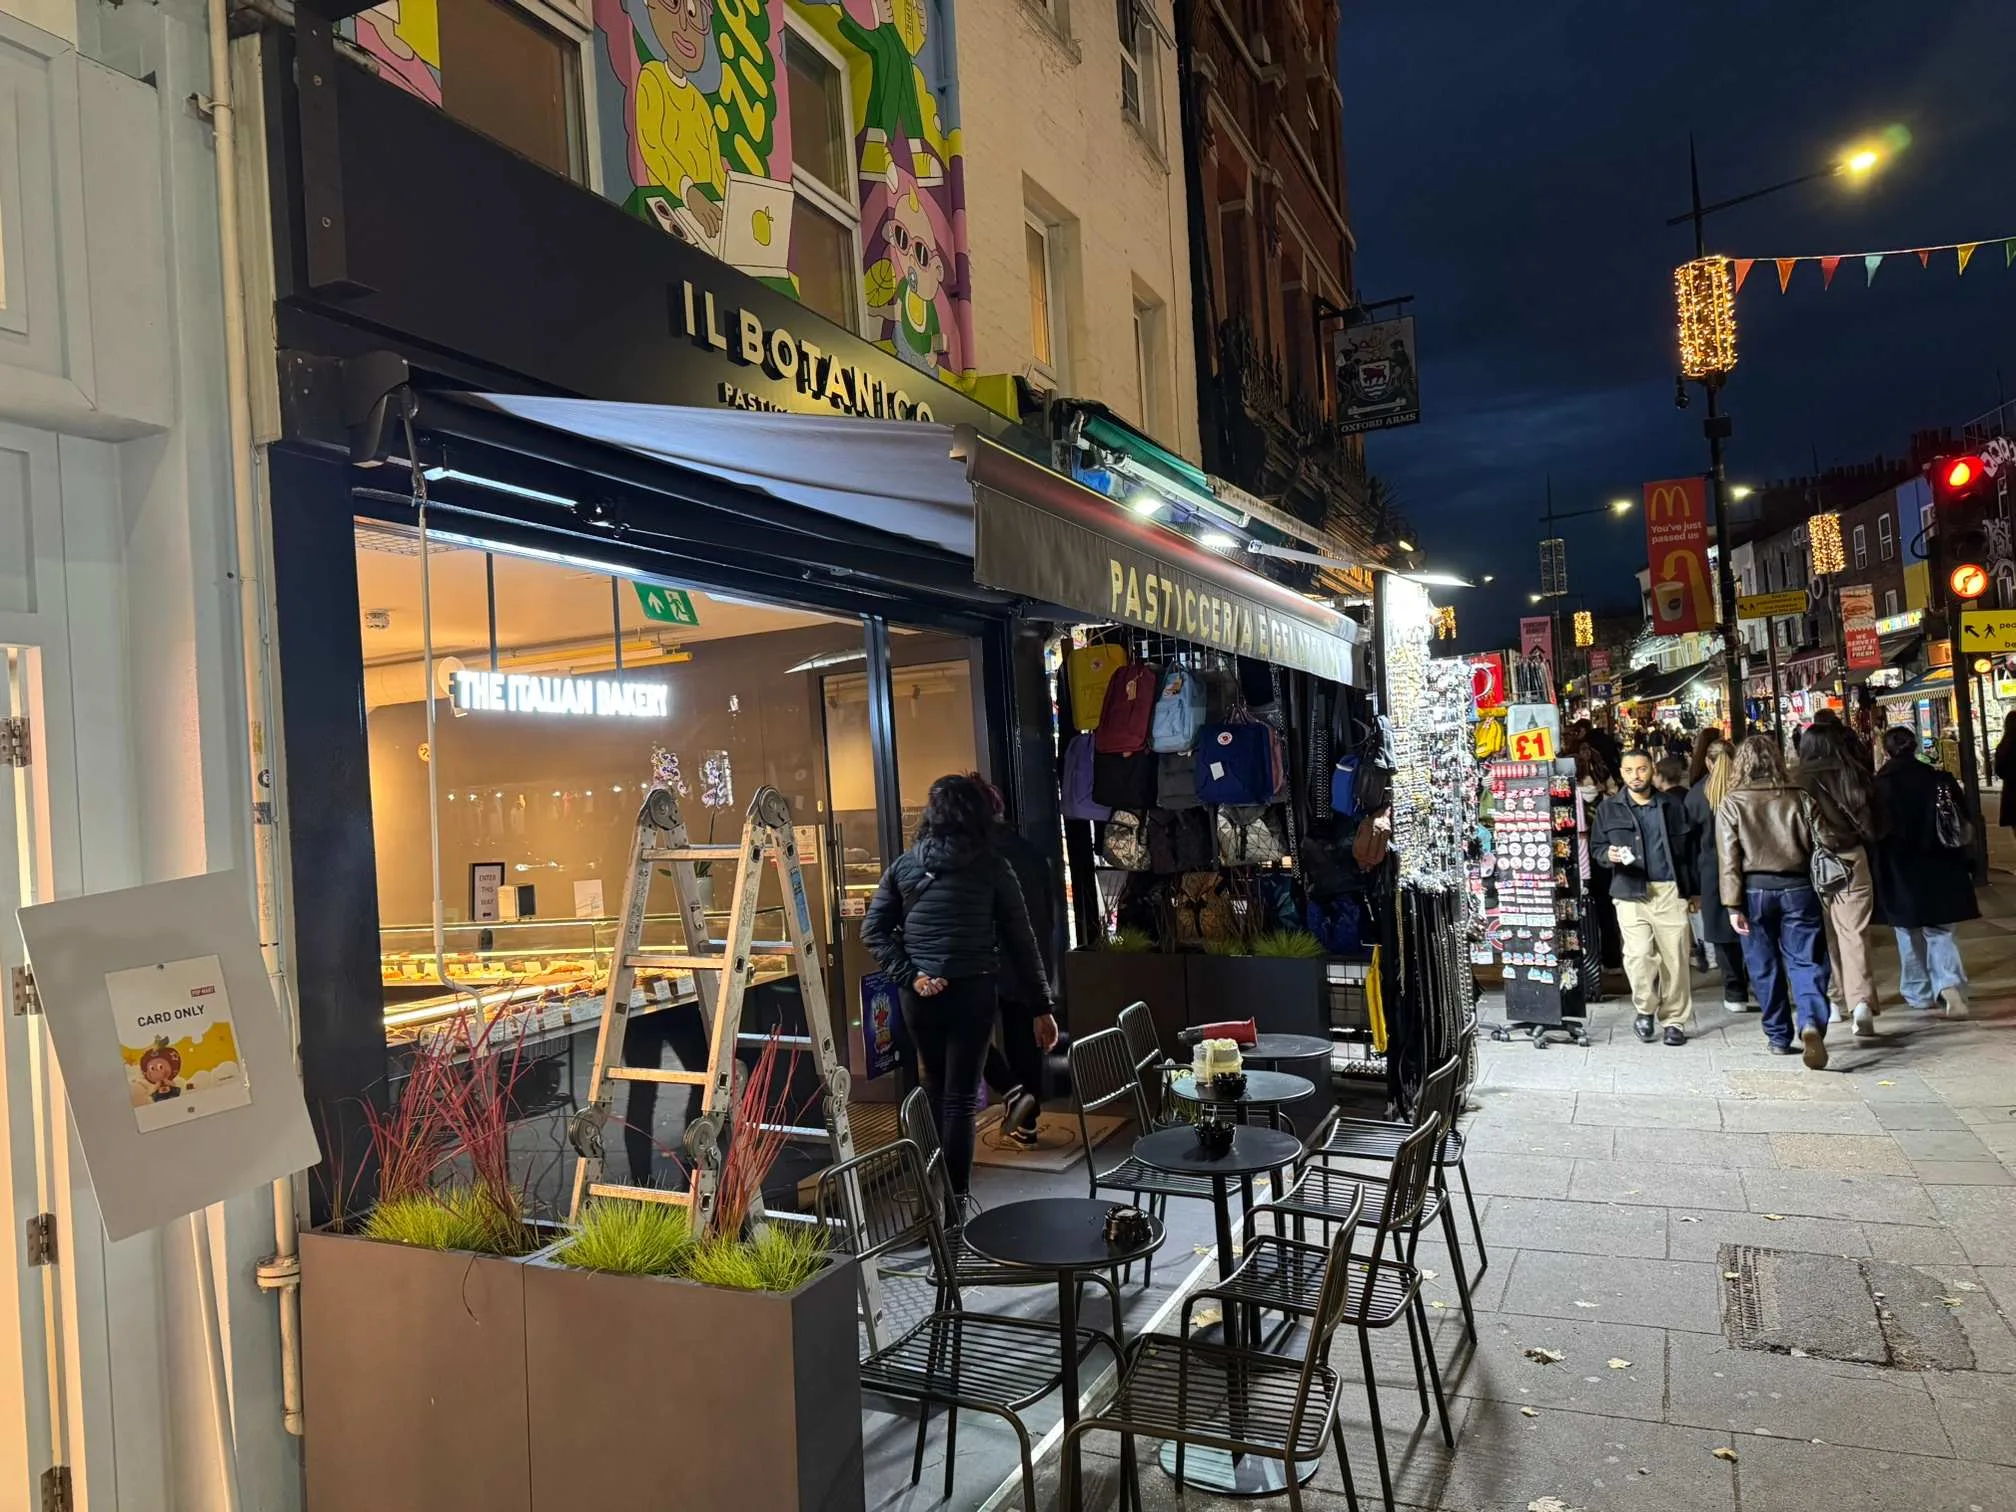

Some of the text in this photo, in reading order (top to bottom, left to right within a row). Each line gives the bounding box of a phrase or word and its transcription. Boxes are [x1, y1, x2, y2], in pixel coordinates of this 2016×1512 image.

[683, 280, 727, 350] IL
[1341, 413, 1417, 433] OXFORD ARMS
[1651, 521, 1702, 534] You've just
[1652, 531, 1699, 545] passed us
[1110, 559, 1254, 658] PASTICCERIA
[457, 670, 668, 717] THE ITALIAN BAKERY
[1516, 732, 1546, 760] £1
[137, 1004, 205, 1027] CARD ONLY
